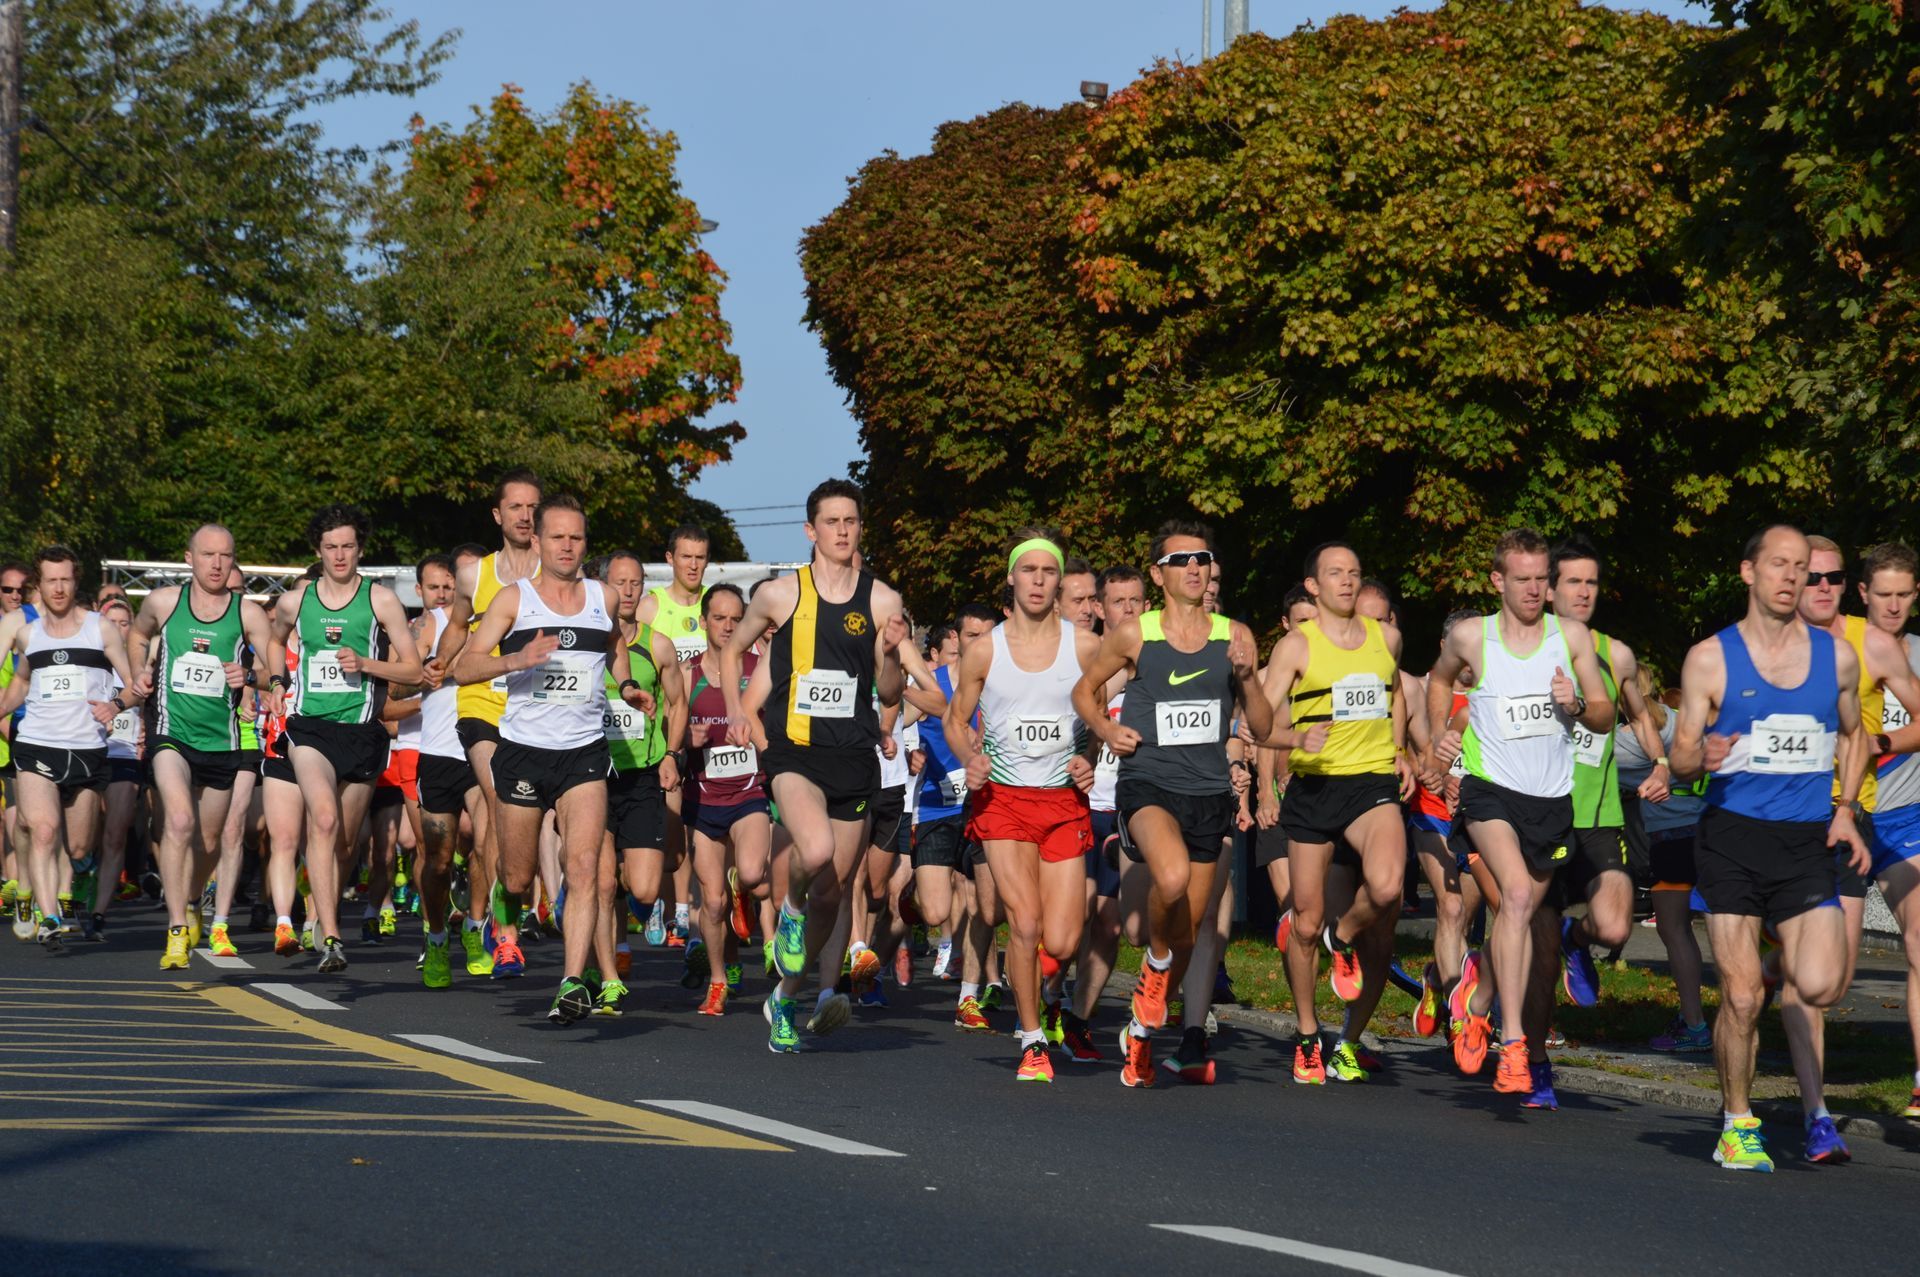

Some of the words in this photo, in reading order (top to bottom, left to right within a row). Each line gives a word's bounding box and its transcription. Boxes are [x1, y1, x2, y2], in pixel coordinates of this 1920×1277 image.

[184, 667, 214, 683] 157
[544, 675, 578, 691] 222
[53, 678, 71, 690] 29
[809, 686, 842, 702] 620
[1346, 690, 1375, 706] 808
[1165, 711, 1211, 729] 1020
[1505, 702, 1553, 722] 1005
[602, 714, 632, 728] 980
[1015, 725, 1061, 742] 1004
[1768, 735, 1808, 754] 344
[711, 750, 748, 766] 1010
